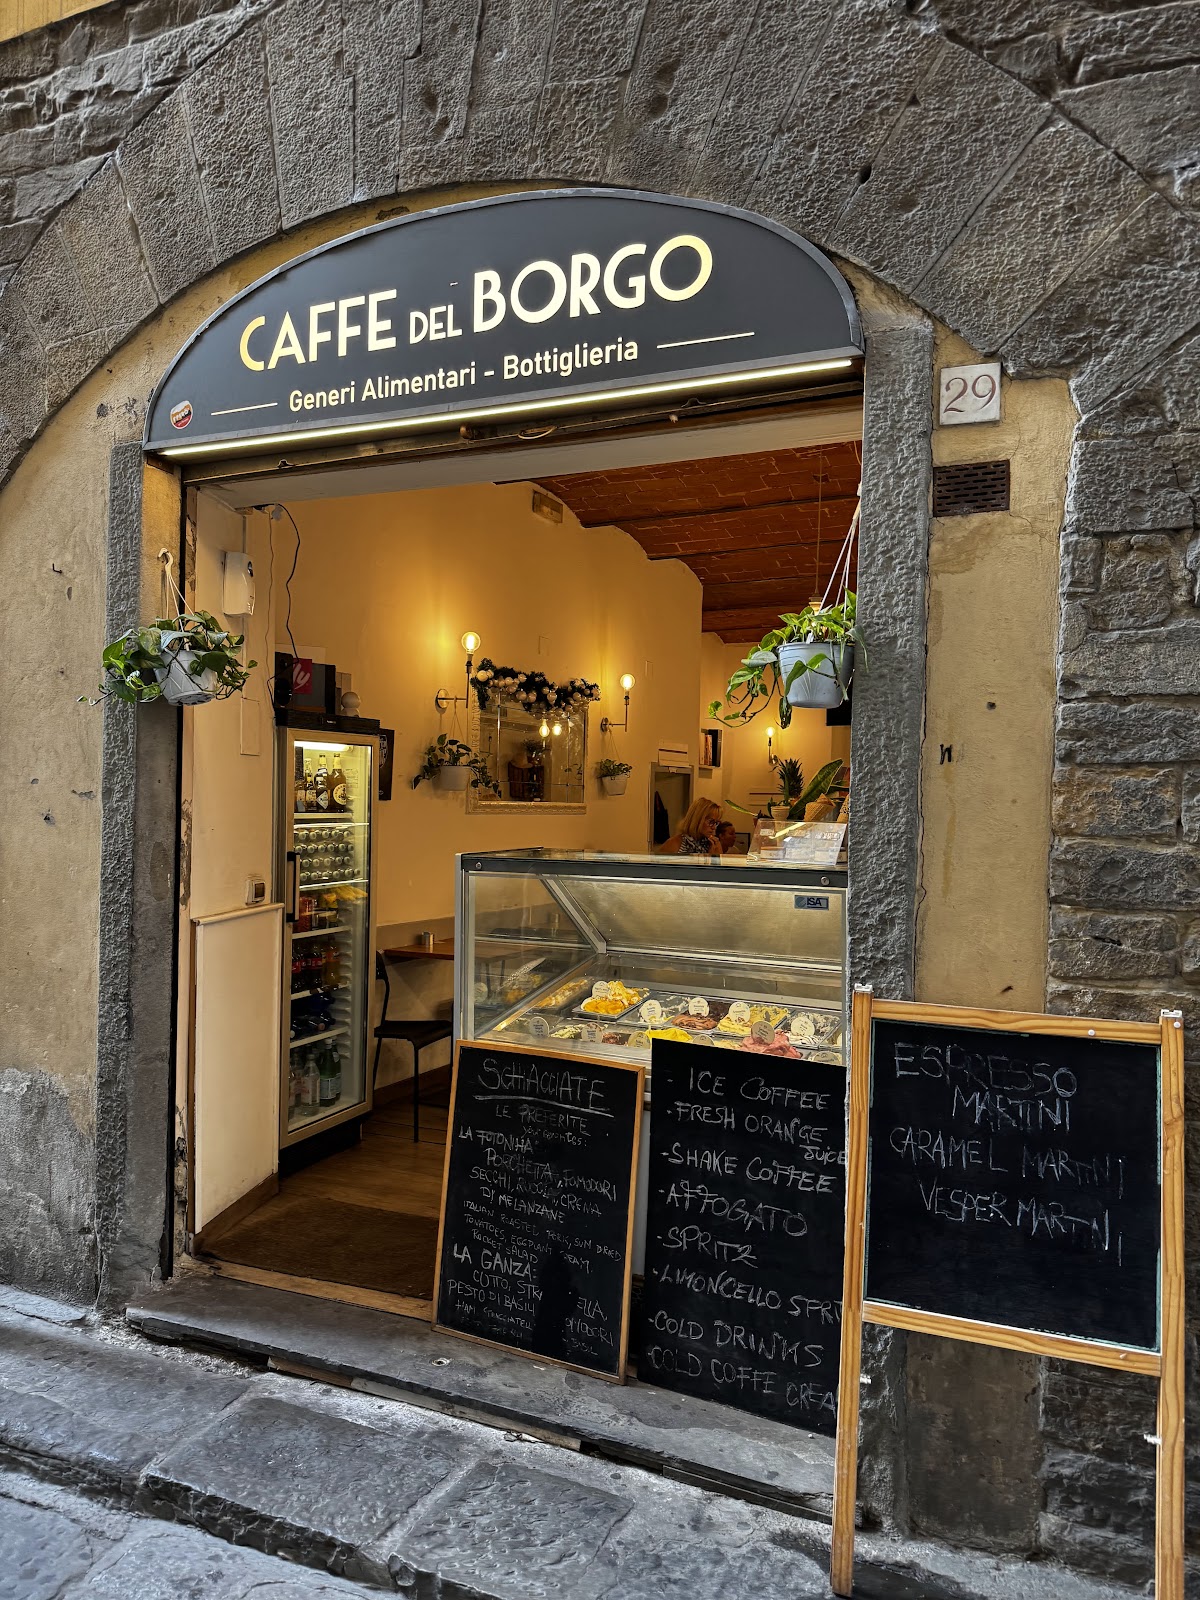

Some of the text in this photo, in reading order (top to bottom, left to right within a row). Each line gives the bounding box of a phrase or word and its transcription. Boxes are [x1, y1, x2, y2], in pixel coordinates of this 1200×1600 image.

[239, 234, 714, 372] CAFFE DEL BORGO
[289, 380, 356, 414] Generi
[362, 360, 477, 404] Alimentari
[502, 337, 639, 383] Bottiglieria
[943, 374, 997, 414] 29
[806, 897, 822, 907] ISA
[689, 1066, 831, 1110] ICE COFFEE
[894, 1042, 1078, 1098] ESPRESSO
[496, 1105, 512, 1119] LE
[674, 1101, 828, 1144] FRESH ORANGE
[952, 1085, 1070, 1133] MARTINI
[459, 1126, 473, 1141] LA
[889, 1126, 1008, 1172] CARAMEL
[668, 1142, 837, 1193] SHAKE COFFEE
[918, 1177, 1012, 1227] VESPER
[453, 1242, 472, 1264] LA
[654, 1309, 704, 1340] COLD
[650, 1345, 702, 1377] COLD
[786, 1382, 838, 1419] CREA
